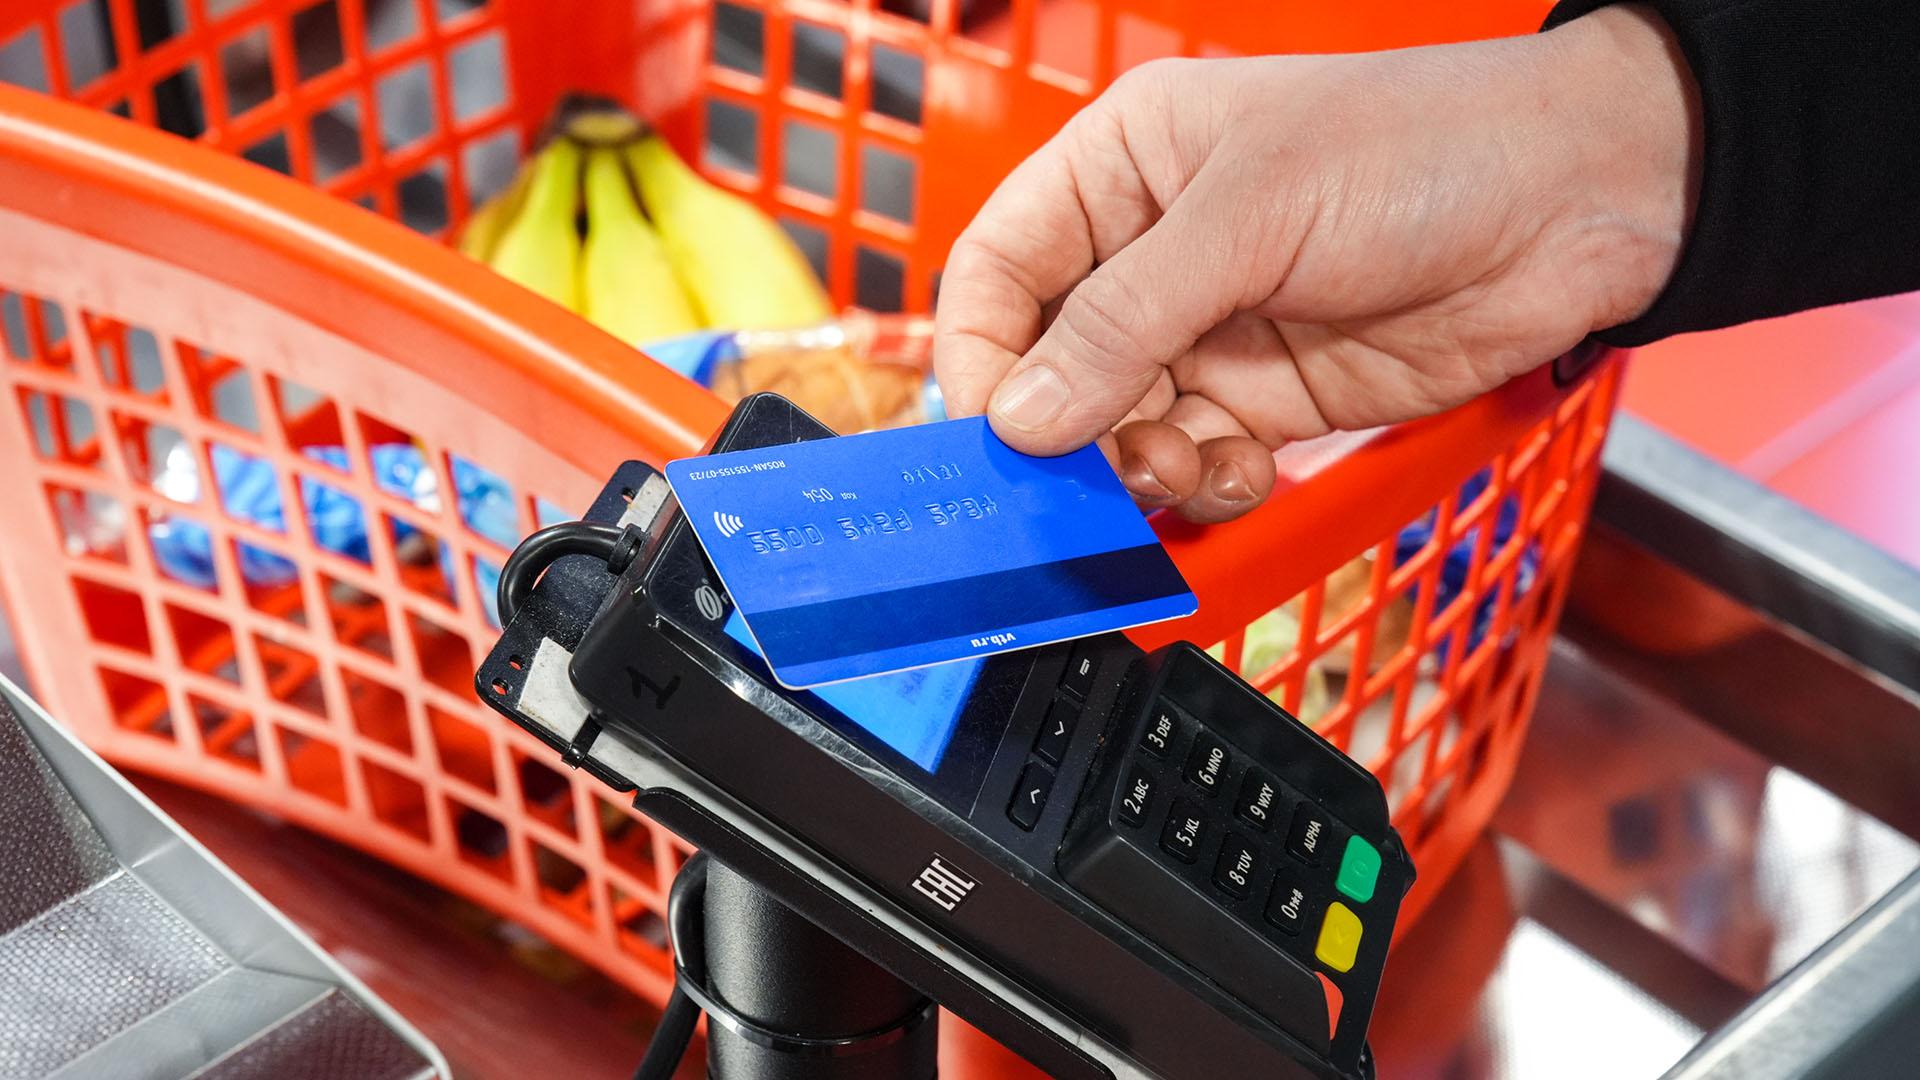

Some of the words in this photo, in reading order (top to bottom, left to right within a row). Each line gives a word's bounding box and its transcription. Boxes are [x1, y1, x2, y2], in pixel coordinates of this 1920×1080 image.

[690, 460, 786, 480] ROSAN-155155-07/23
[802, 487, 834, 503] 054
[970, 632, 1017, 647] vtb.ru
[1156, 715, 1172, 738] DEF
[1148, 733, 1165, 748] 3
[1198, 770, 1214, 785] 6
[1206, 747, 1224, 776] MNO
[1123, 798, 1141, 815] 2
[1133, 778, 1149, 804] ABC
[1257, 782, 1274, 809] WXY
[1249, 804, 1266, 820] 9
[1176, 831, 1193, 847] 5
[1185, 818, 1200, 837] JKL
[1303, 820, 1322, 853] ALPHA
[1237, 849, 1253, 874] TUV
[911, 858, 975, 911] EAC
[1229, 870, 1246, 886] 8
[1281, 904, 1298, 920] 0
